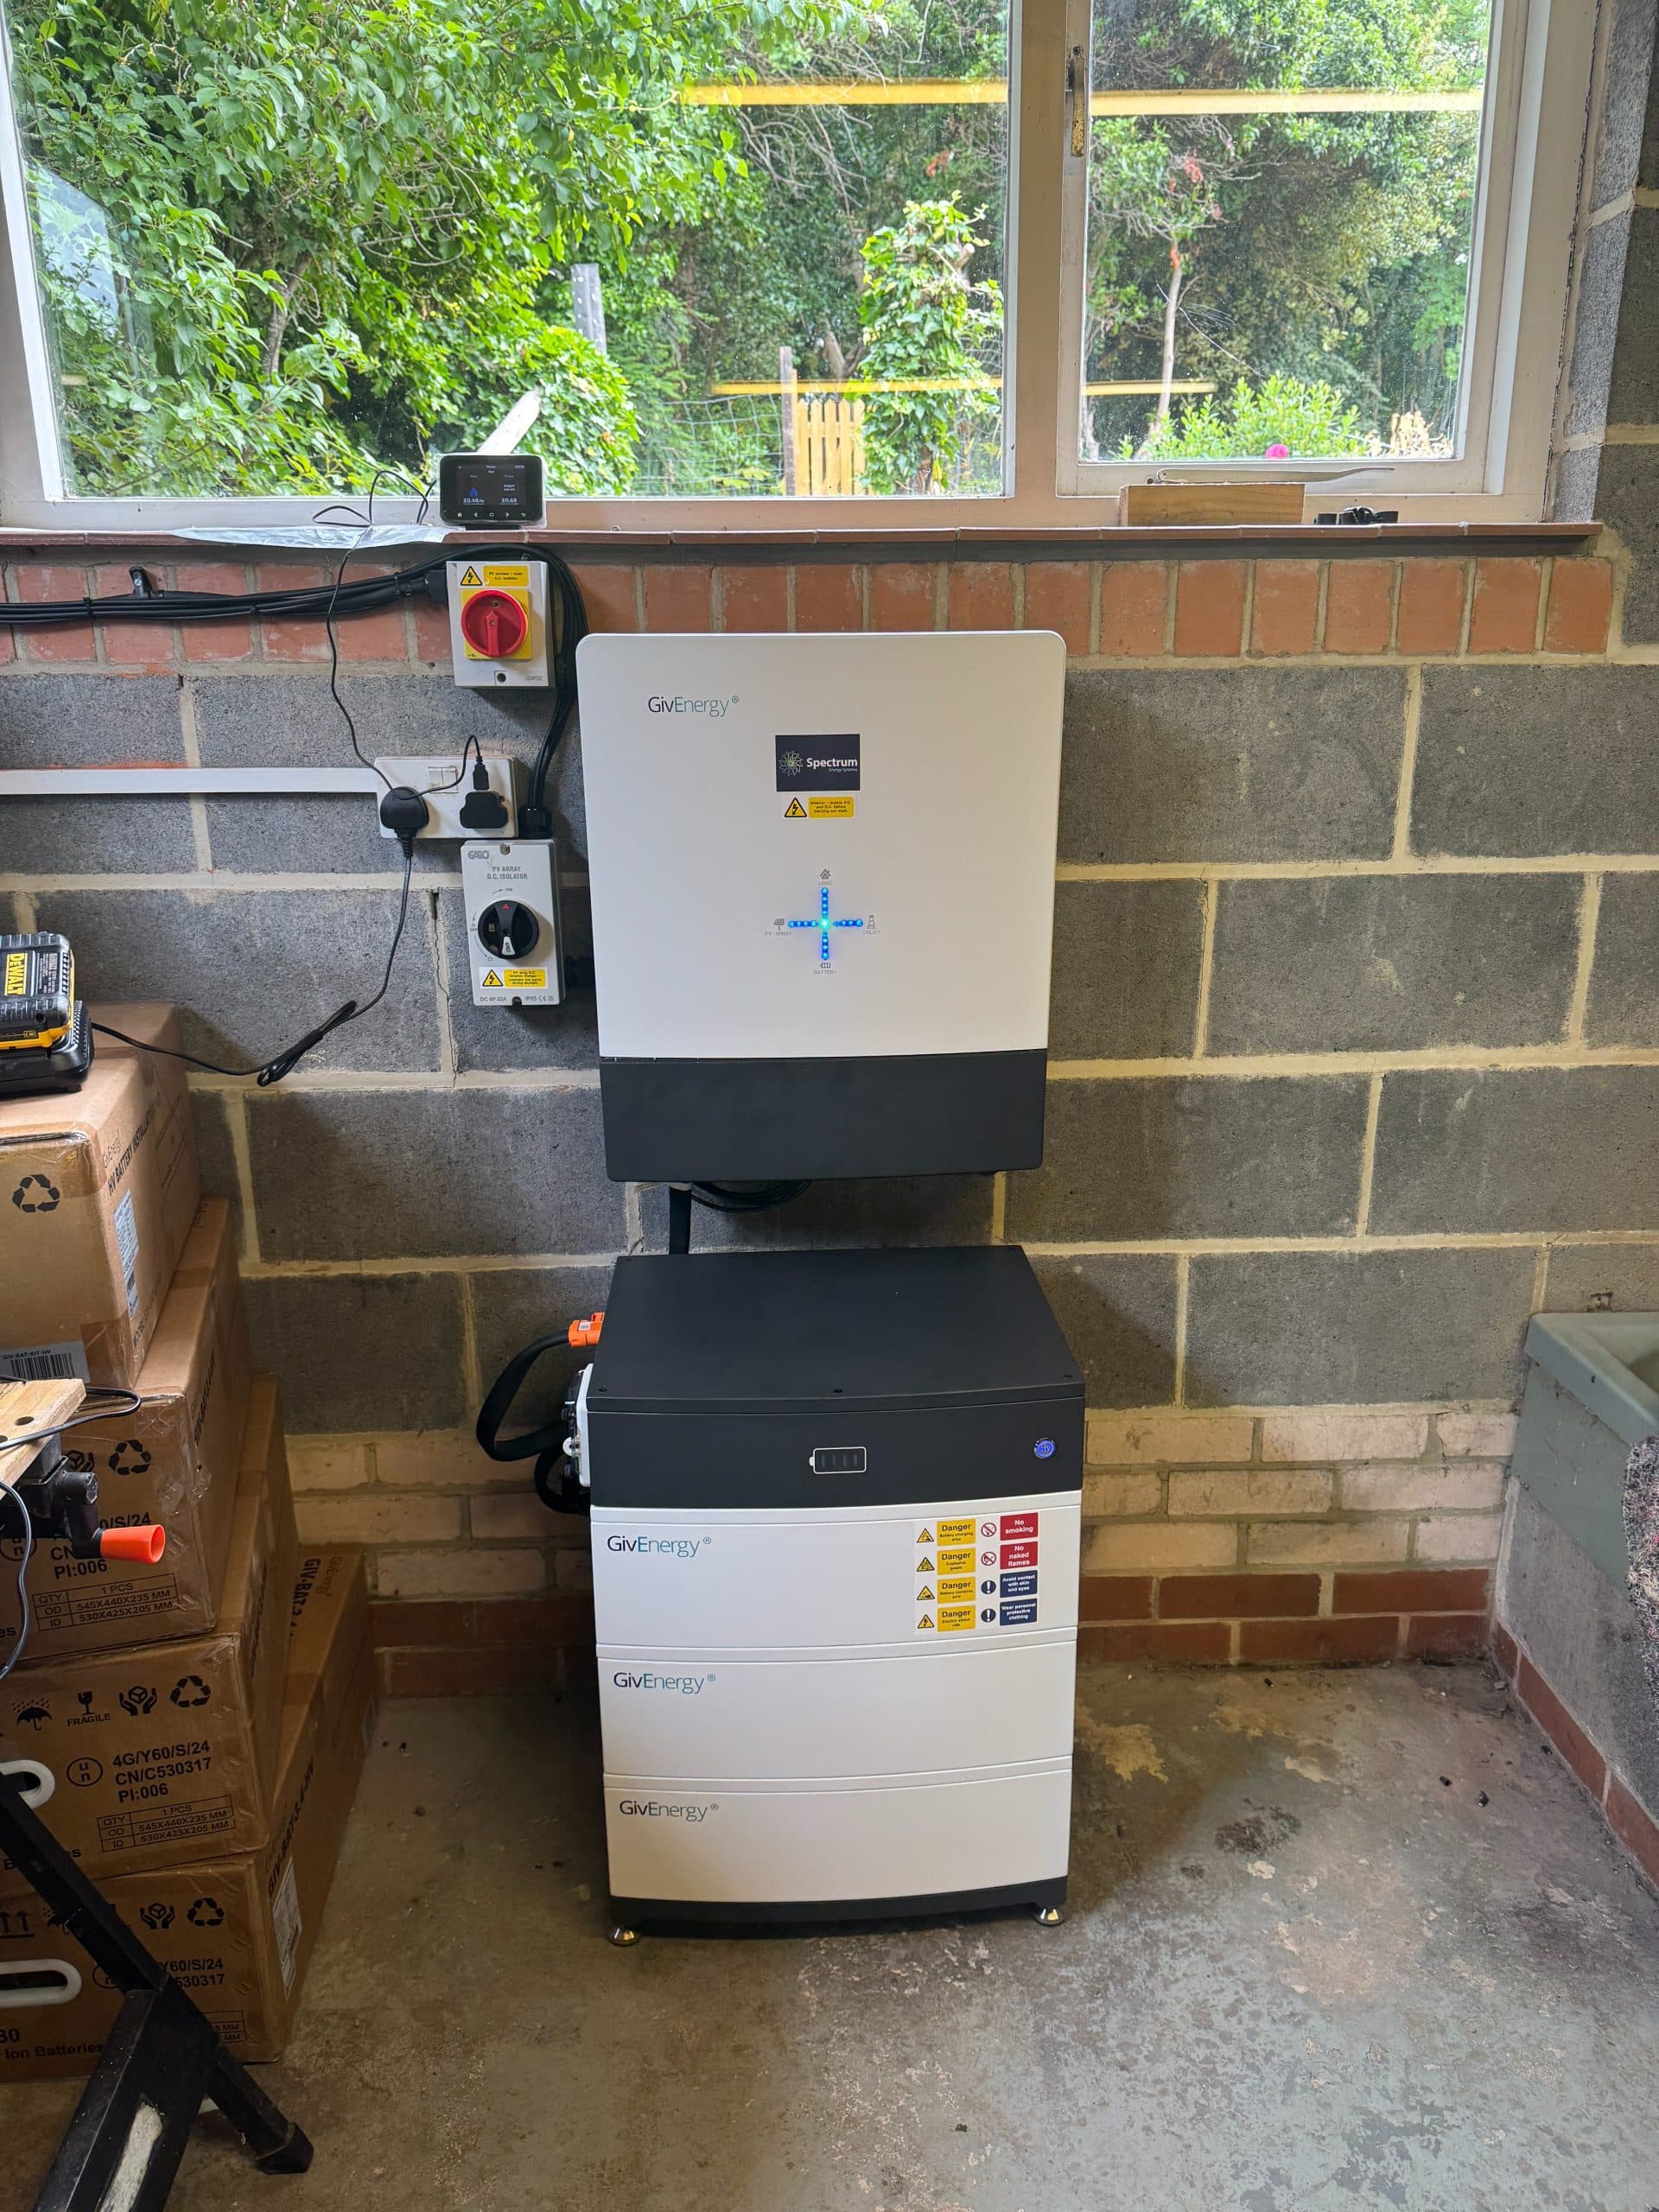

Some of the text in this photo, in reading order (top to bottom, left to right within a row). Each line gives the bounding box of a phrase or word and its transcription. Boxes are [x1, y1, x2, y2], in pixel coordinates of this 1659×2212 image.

[806, 757, 858, 769] Spectrum
[54, 1560, 108, 1580] PI:006
[38, 1593, 62, 1604] QTY
[111, 1583, 133, 1592] PCS
[44, 1589, 171, 1615] OD 545X440X235 MM
[50, 1602, 173, 1627] ID 530X425X205 MM
[67, 1713, 111, 1727] FRAGILE
[113, 1740, 210, 1767] 4G/Y60/S/24
[115, 1757, 211, 1786] CN/C530317
[118, 1783, 168, 1803] PI:006
[103, 1815, 125, 1826] QTY
[170, 1805, 193, 1814] PCS
[108, 1810, 227, 1837] OD 545X440X235 MM
[113, 1820, 229, 1848] ID 530X425X205 MM
[160, 1958, 223, 1971] Y60/S/24
[175, 1974, 224, 1987] 530317
